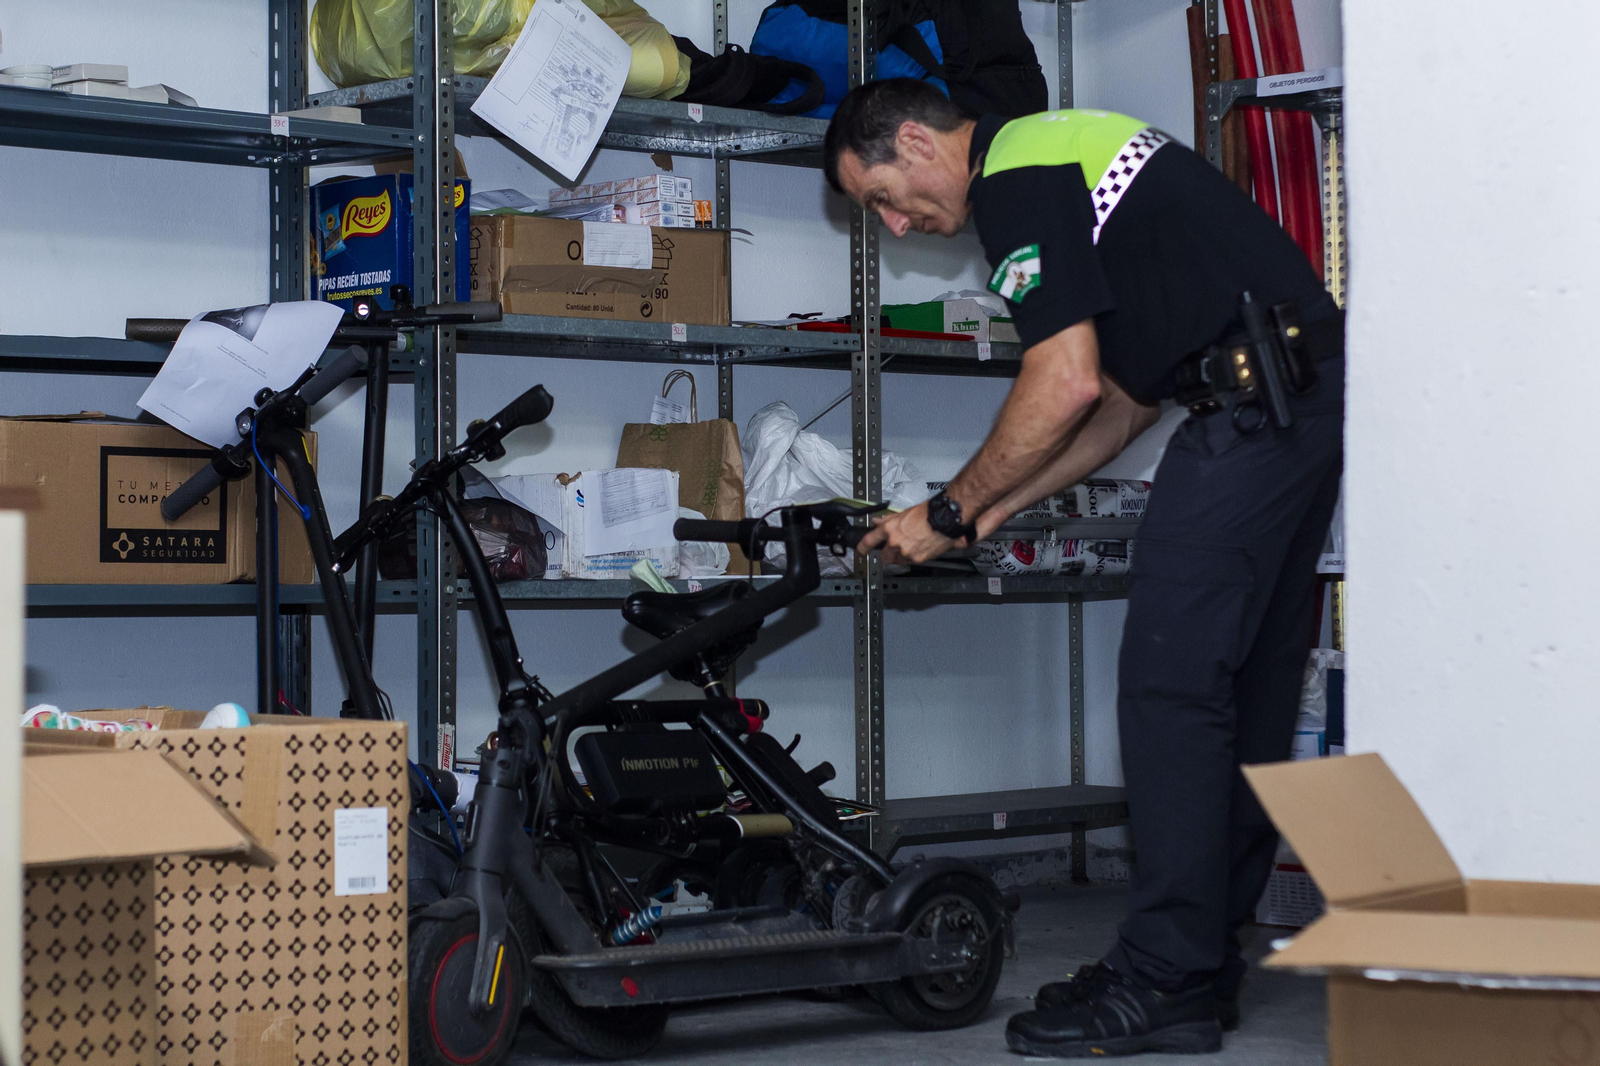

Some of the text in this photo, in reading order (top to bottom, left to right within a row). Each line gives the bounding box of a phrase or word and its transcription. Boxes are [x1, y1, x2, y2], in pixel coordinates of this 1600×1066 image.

[1269, 75, 1325, 88] OBJETOS PERDIDOS
[345, 201, 386, 232] Reyes
[318, 269, 392, 291] PIPAS RECIÉN TOSTADAS
[566, 303, 615, 313] Cantidad: 80 Unid.
[118, 480, 137, 490] TU
[143, 536, 215, 547] SATARA
[143, 550, 215, 558] SEGURIDAD
